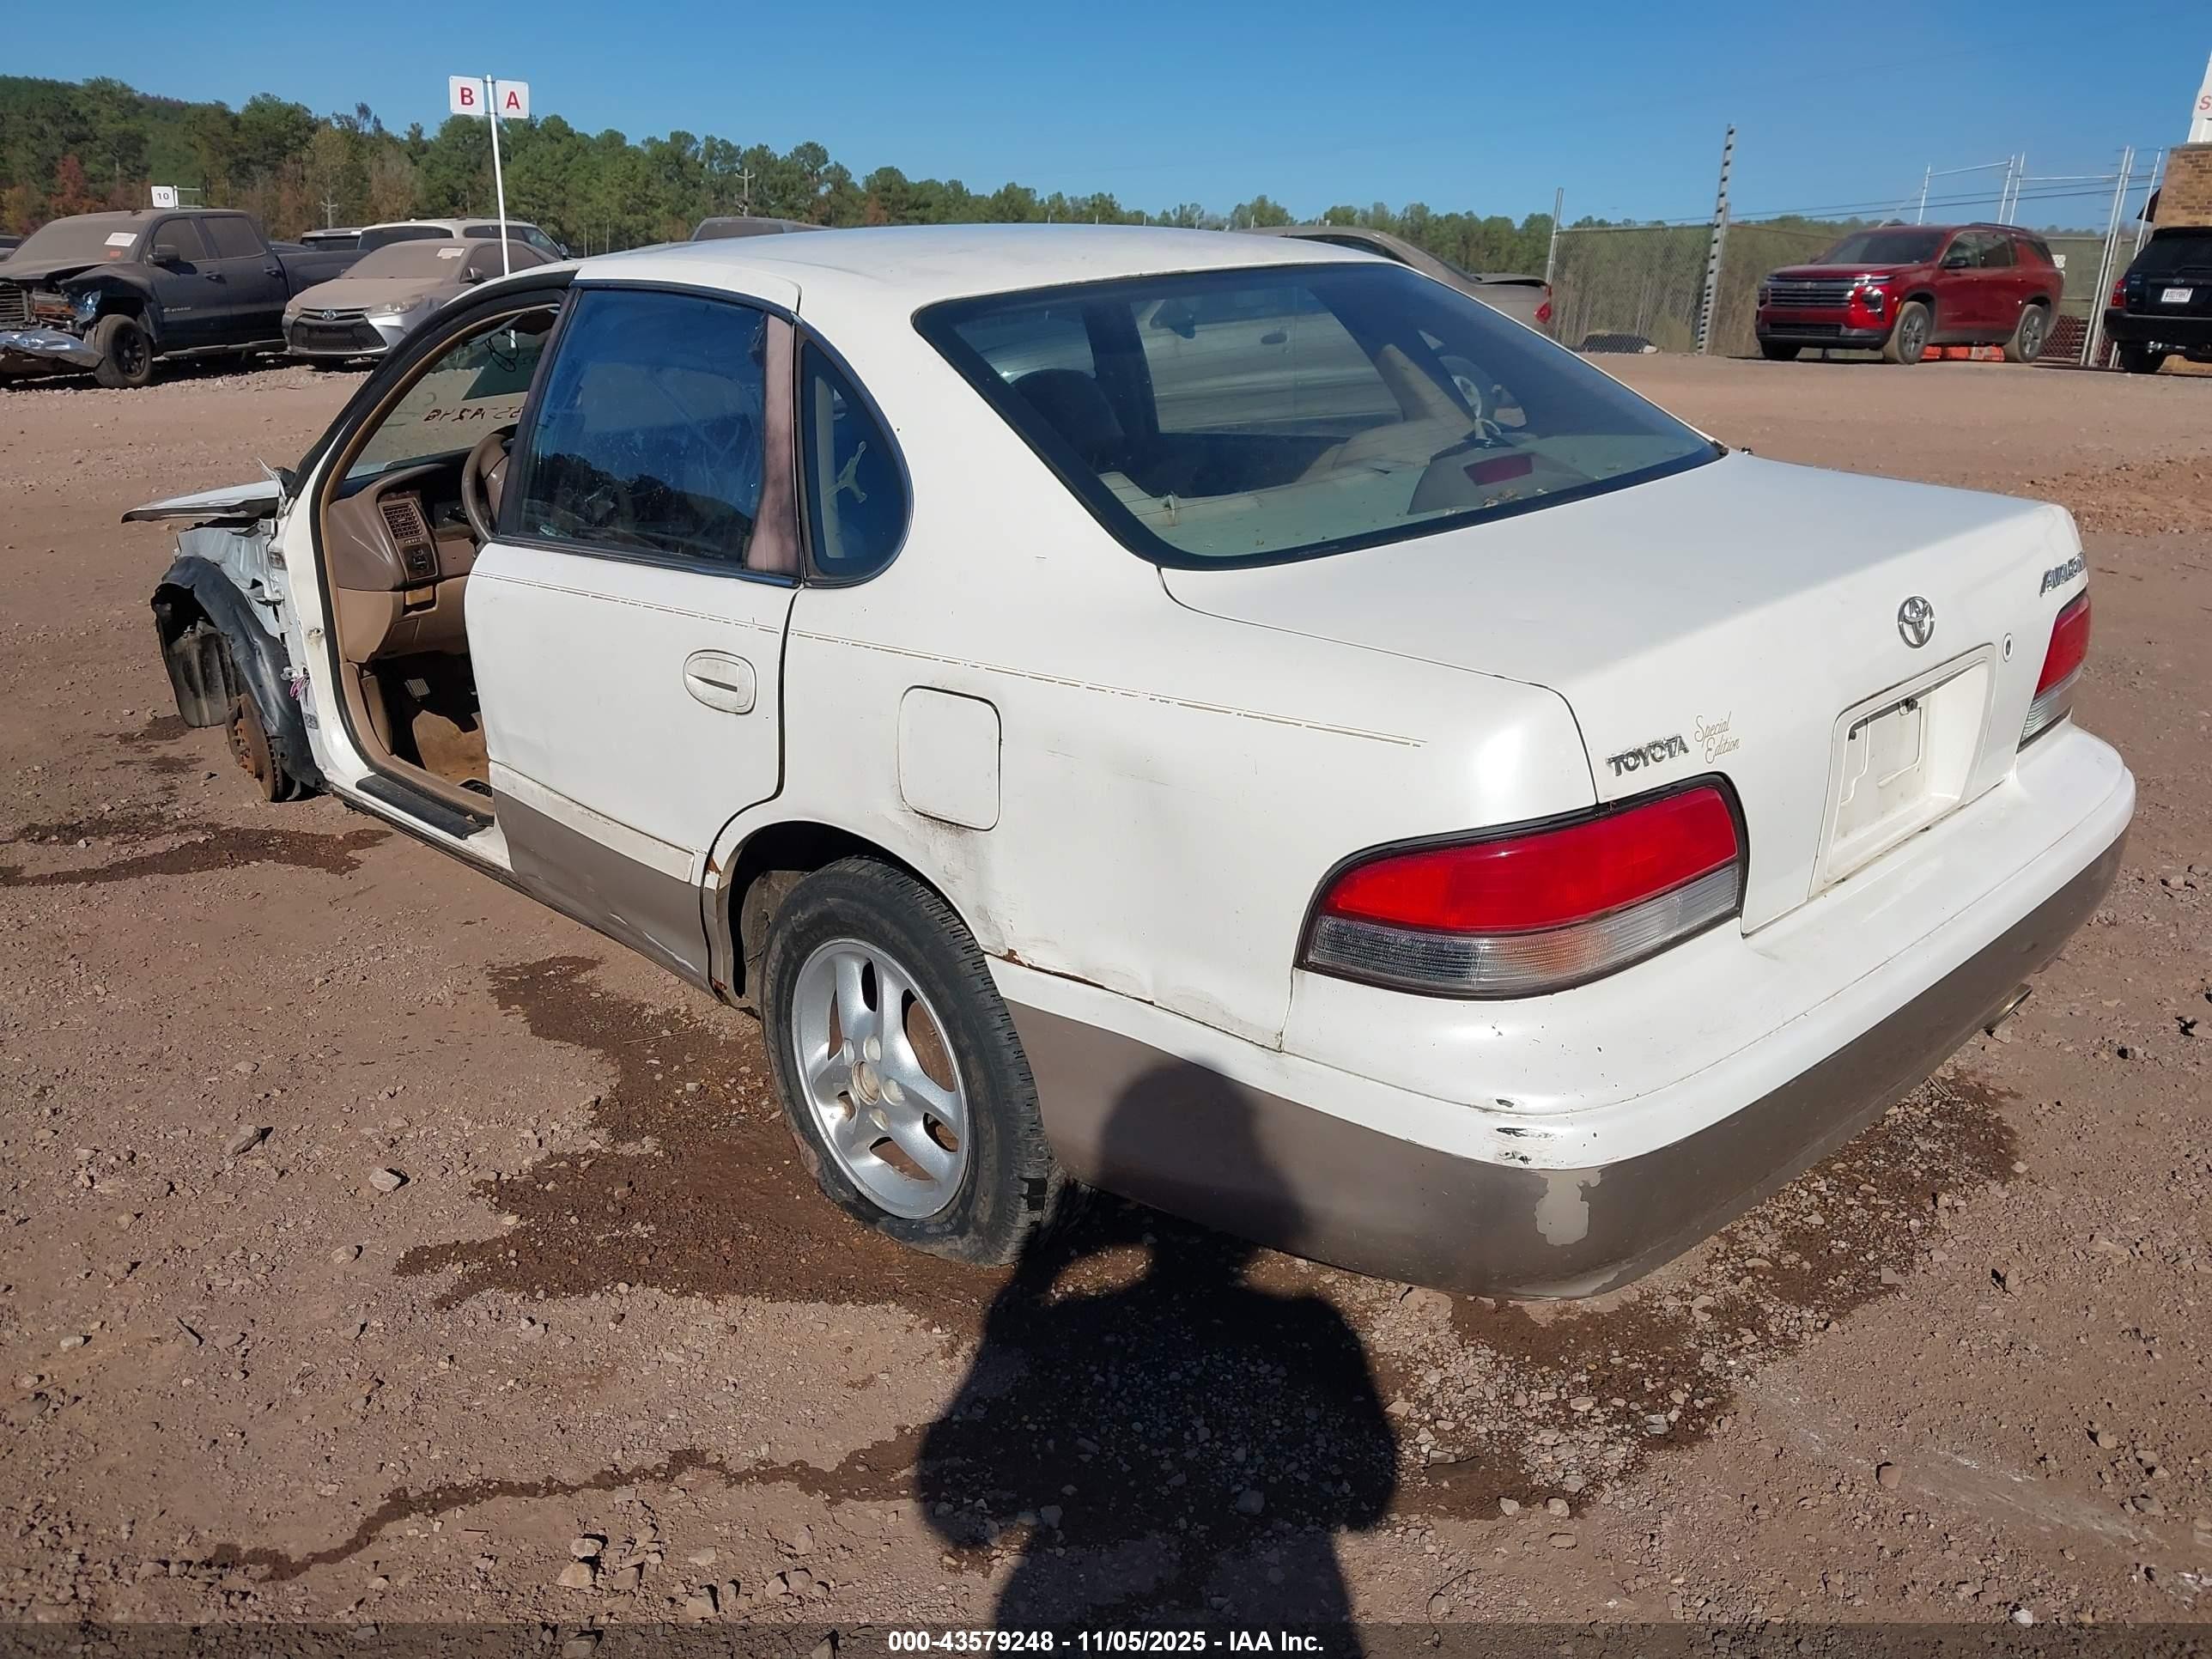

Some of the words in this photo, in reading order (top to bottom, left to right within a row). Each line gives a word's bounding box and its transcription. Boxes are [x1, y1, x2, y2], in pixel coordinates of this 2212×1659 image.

[460, 87, 474, 106] B
[506, 91, 520, 110] A
[1694, 710, 1732, 749] Special
[1607, 734, 1689, 777] TOYOTA
[1705, 736, 1741, 765] Edition
